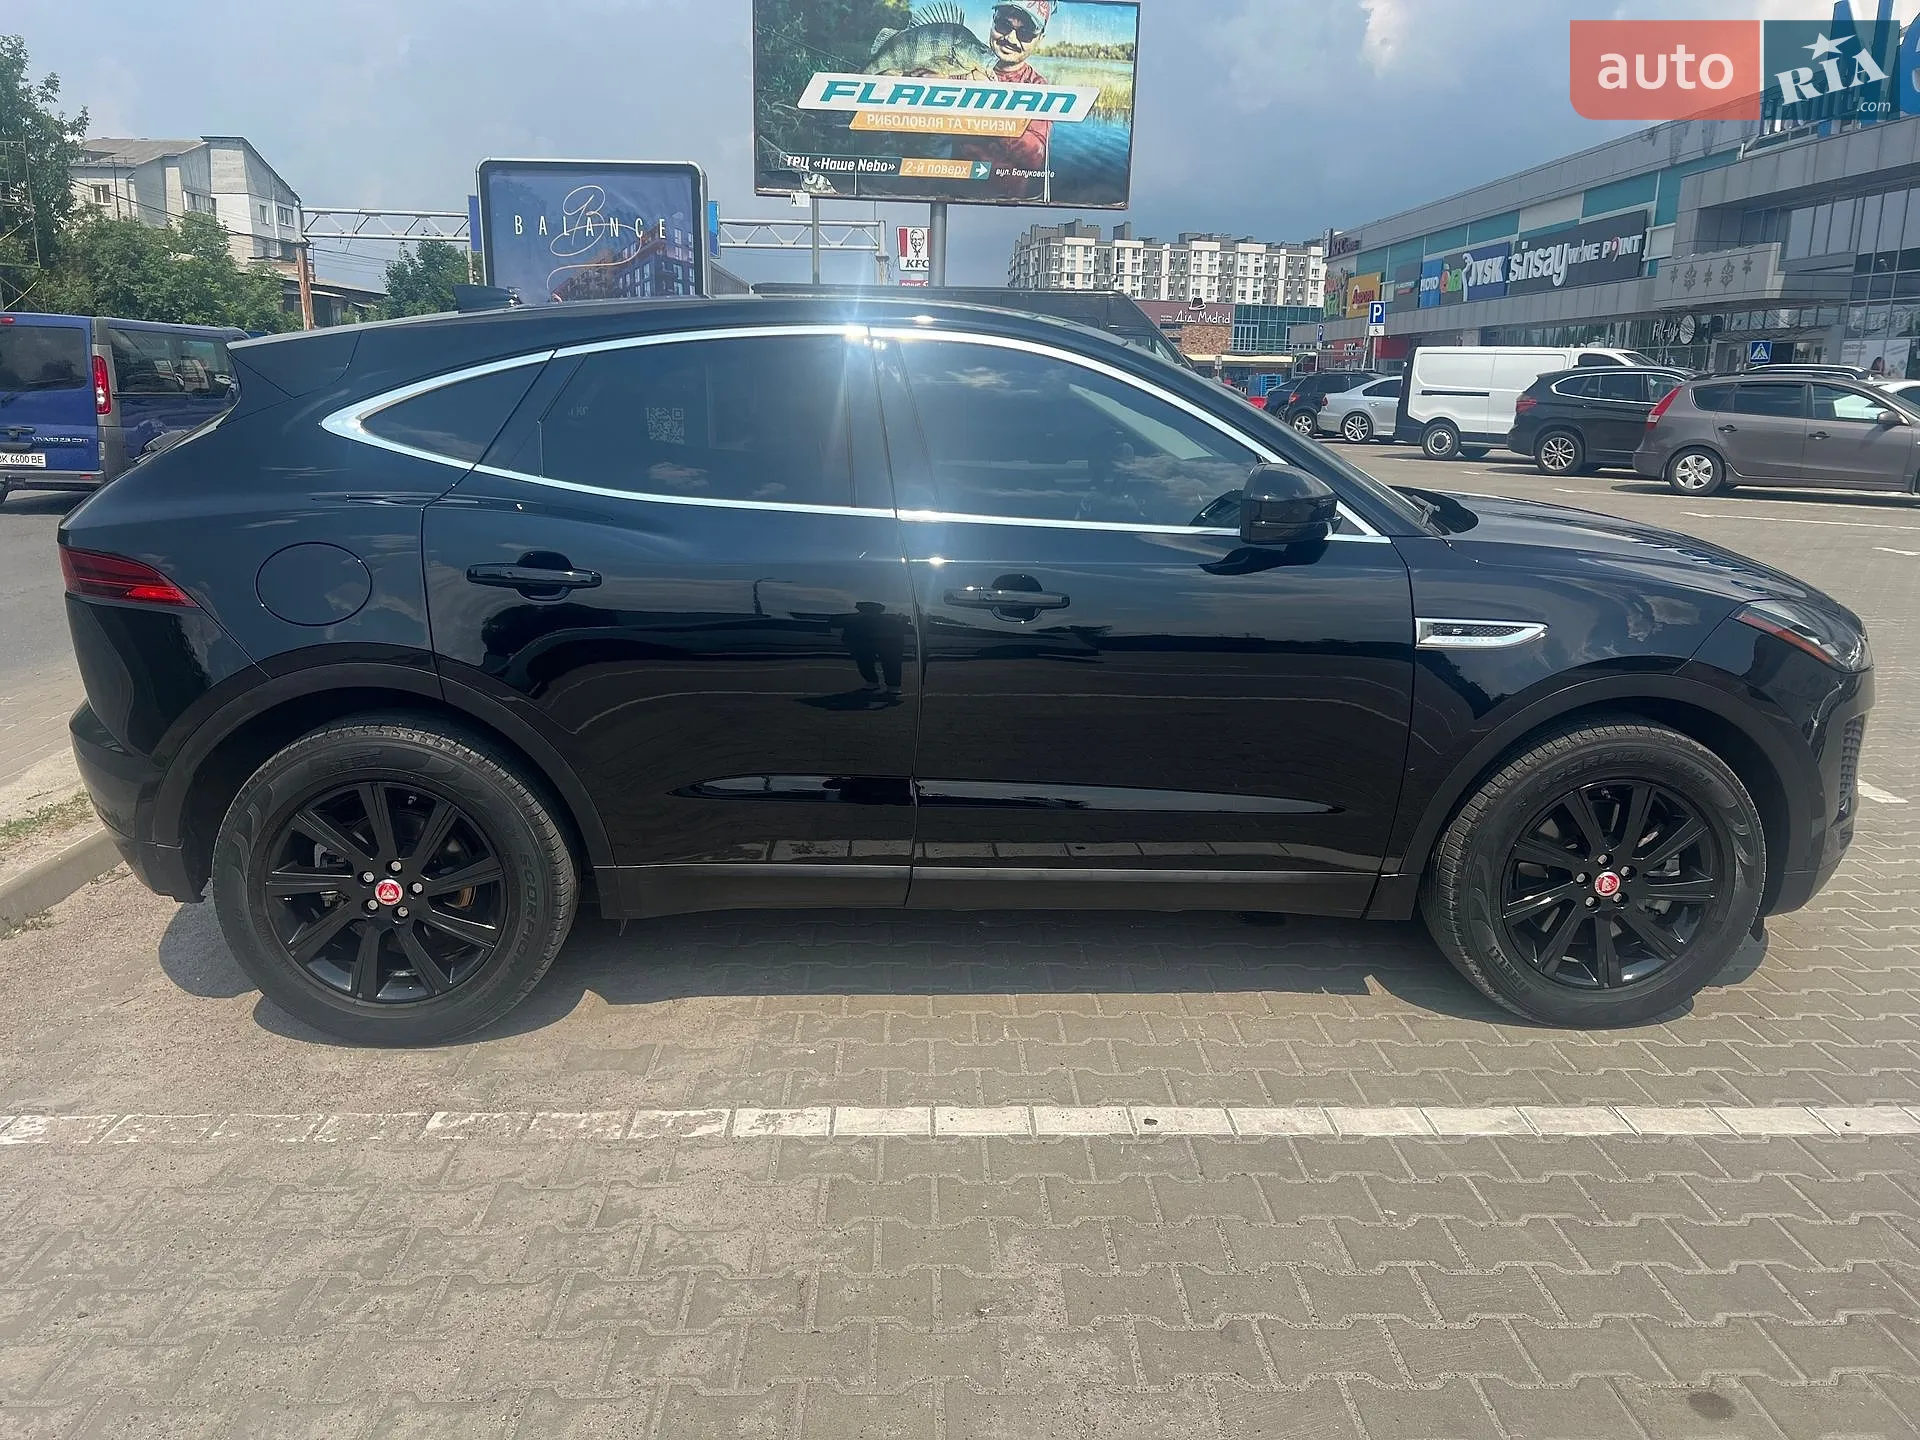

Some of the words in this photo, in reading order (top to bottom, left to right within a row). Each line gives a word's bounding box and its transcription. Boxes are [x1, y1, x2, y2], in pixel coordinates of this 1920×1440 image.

[820, 80, 1078, 115] FLAGMAN
[867, 113, 944, 129] РИБОЛОВЛЯ
[945, 118, 962, 129] ТА
[966, 118, 1017, 132] ТУРИЗМ
[786, 155, 810, 171] ТРЦ
[813, 157, 855, 171] «Наше
[904, 162, 924, 174] 2-й
[927, 164, 968, 178] поверх
[514, 215, 666, 240] BALANCE
[1602, 235, 1643, 262] POINT
[1468, 256, 1506, 287] JYSK
[1509, 241, 1570, 286] sinsay
[1197, 310, 1231, 324] Madrid
[1373, 304, 1382, 322] P
[10, 455, 30, 464] 6600
[31, 455, 44, 464] BE
